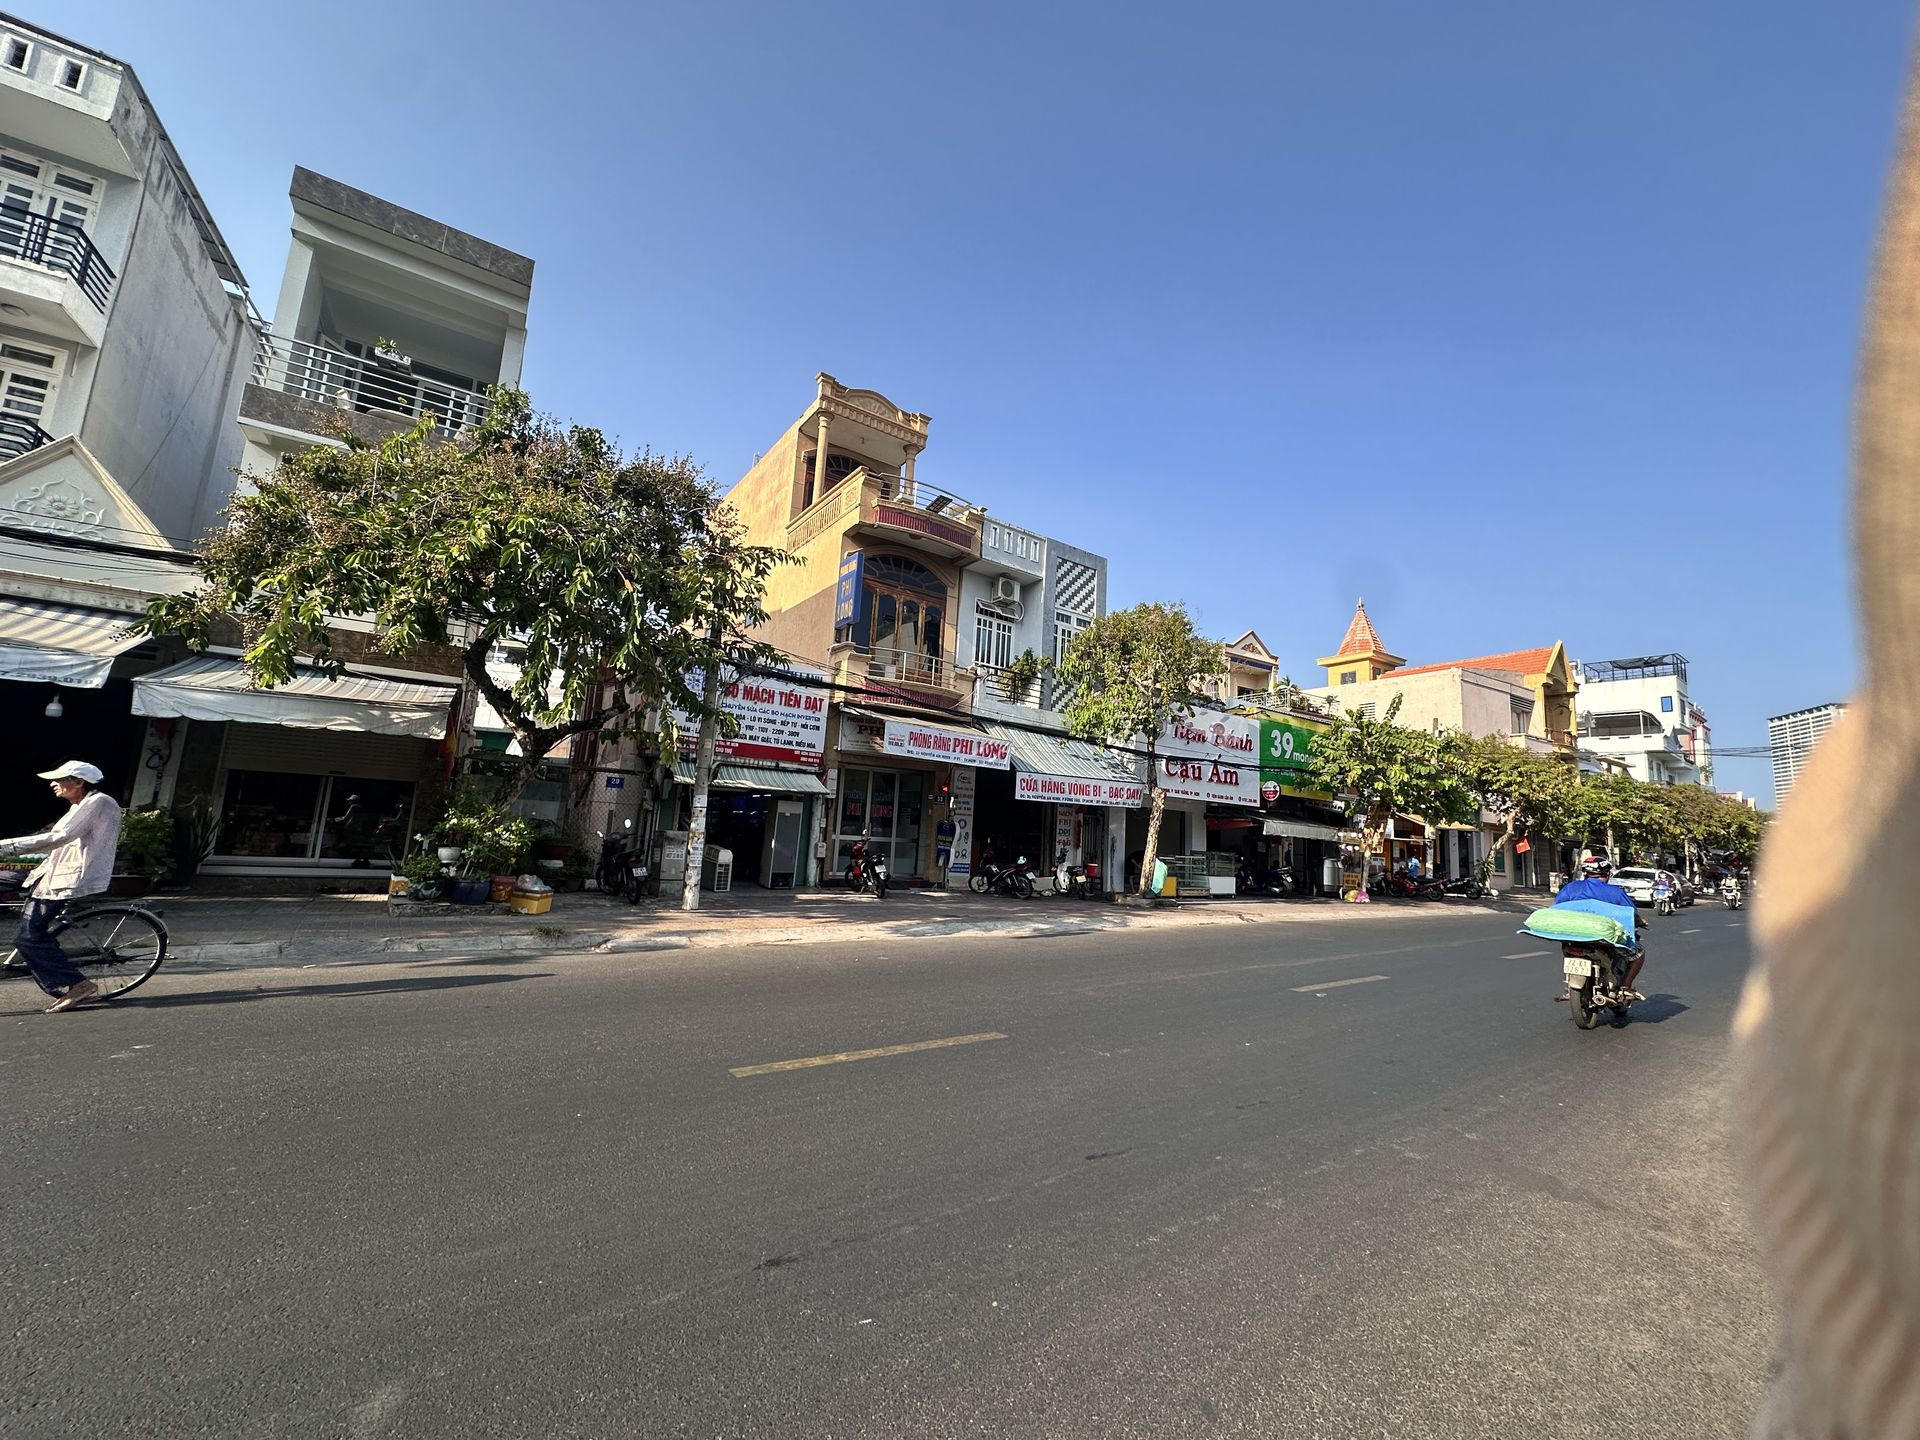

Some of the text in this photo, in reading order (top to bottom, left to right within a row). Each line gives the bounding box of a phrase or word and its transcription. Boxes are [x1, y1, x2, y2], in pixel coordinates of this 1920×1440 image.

[721, 702, 746, 711] CHUYÊN
[746, 705, 758, 713] SỬA
[758, 707, 770, 715] CÁC
[797, 714, 821, 722] INVERTER
[742, 685, 776, 705] MẠCH
[779, 688, 802, 709] TIẾN
[804, 695, 825, 714] ĐẠT
[772, 728, 785, 736] 220V
[908, 729, 932, 749] PHÒNG
[933, 733, 952, 752] RĂNG
[952, 737, 973, 755] PHI
[975, 741, 1008, 760] LONG
[1172, 714, 1254, 752] Tiệm Bánh
[1270, 729, 1294, 759] 39
[1163, 754, 1240, 786] Cậu Ấm
[1019, 774, 1038, 792] CỬA
[1041, 777, 1065, 795] HÀNG
[1068, 780, 1091, 797] VÒNG
[1092, 784, 1101, 797] BI
[1108, 786, 1124, 801] BẠC
[1125, 787, 1143, 803] ĐẠN
